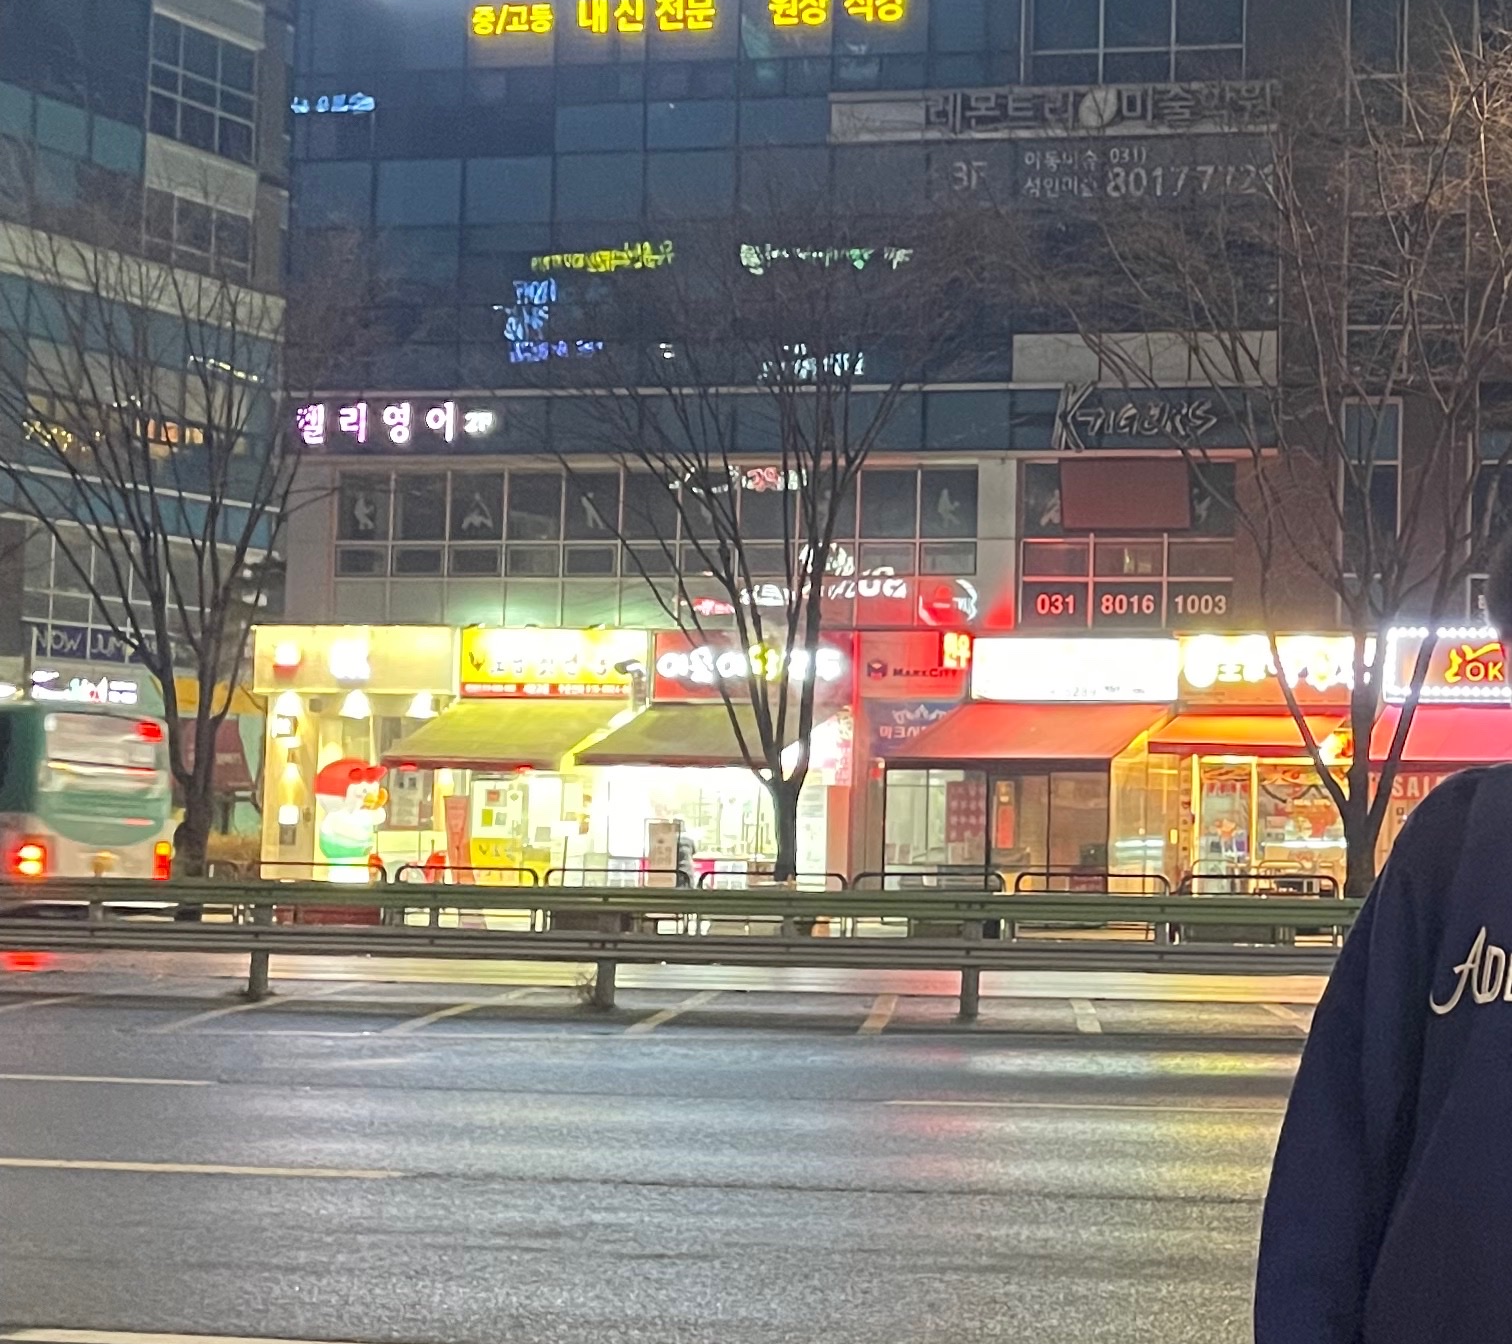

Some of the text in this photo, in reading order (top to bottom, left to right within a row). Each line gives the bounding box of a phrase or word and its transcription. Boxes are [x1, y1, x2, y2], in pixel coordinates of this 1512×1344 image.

[472, 4, 554, 36] 중/고등
[927, 90, 1075, 135] 레몬트리
[1035, 593, 1228, 616] 031 8016 1003
[1391, 775, 1445, 798] SAL
